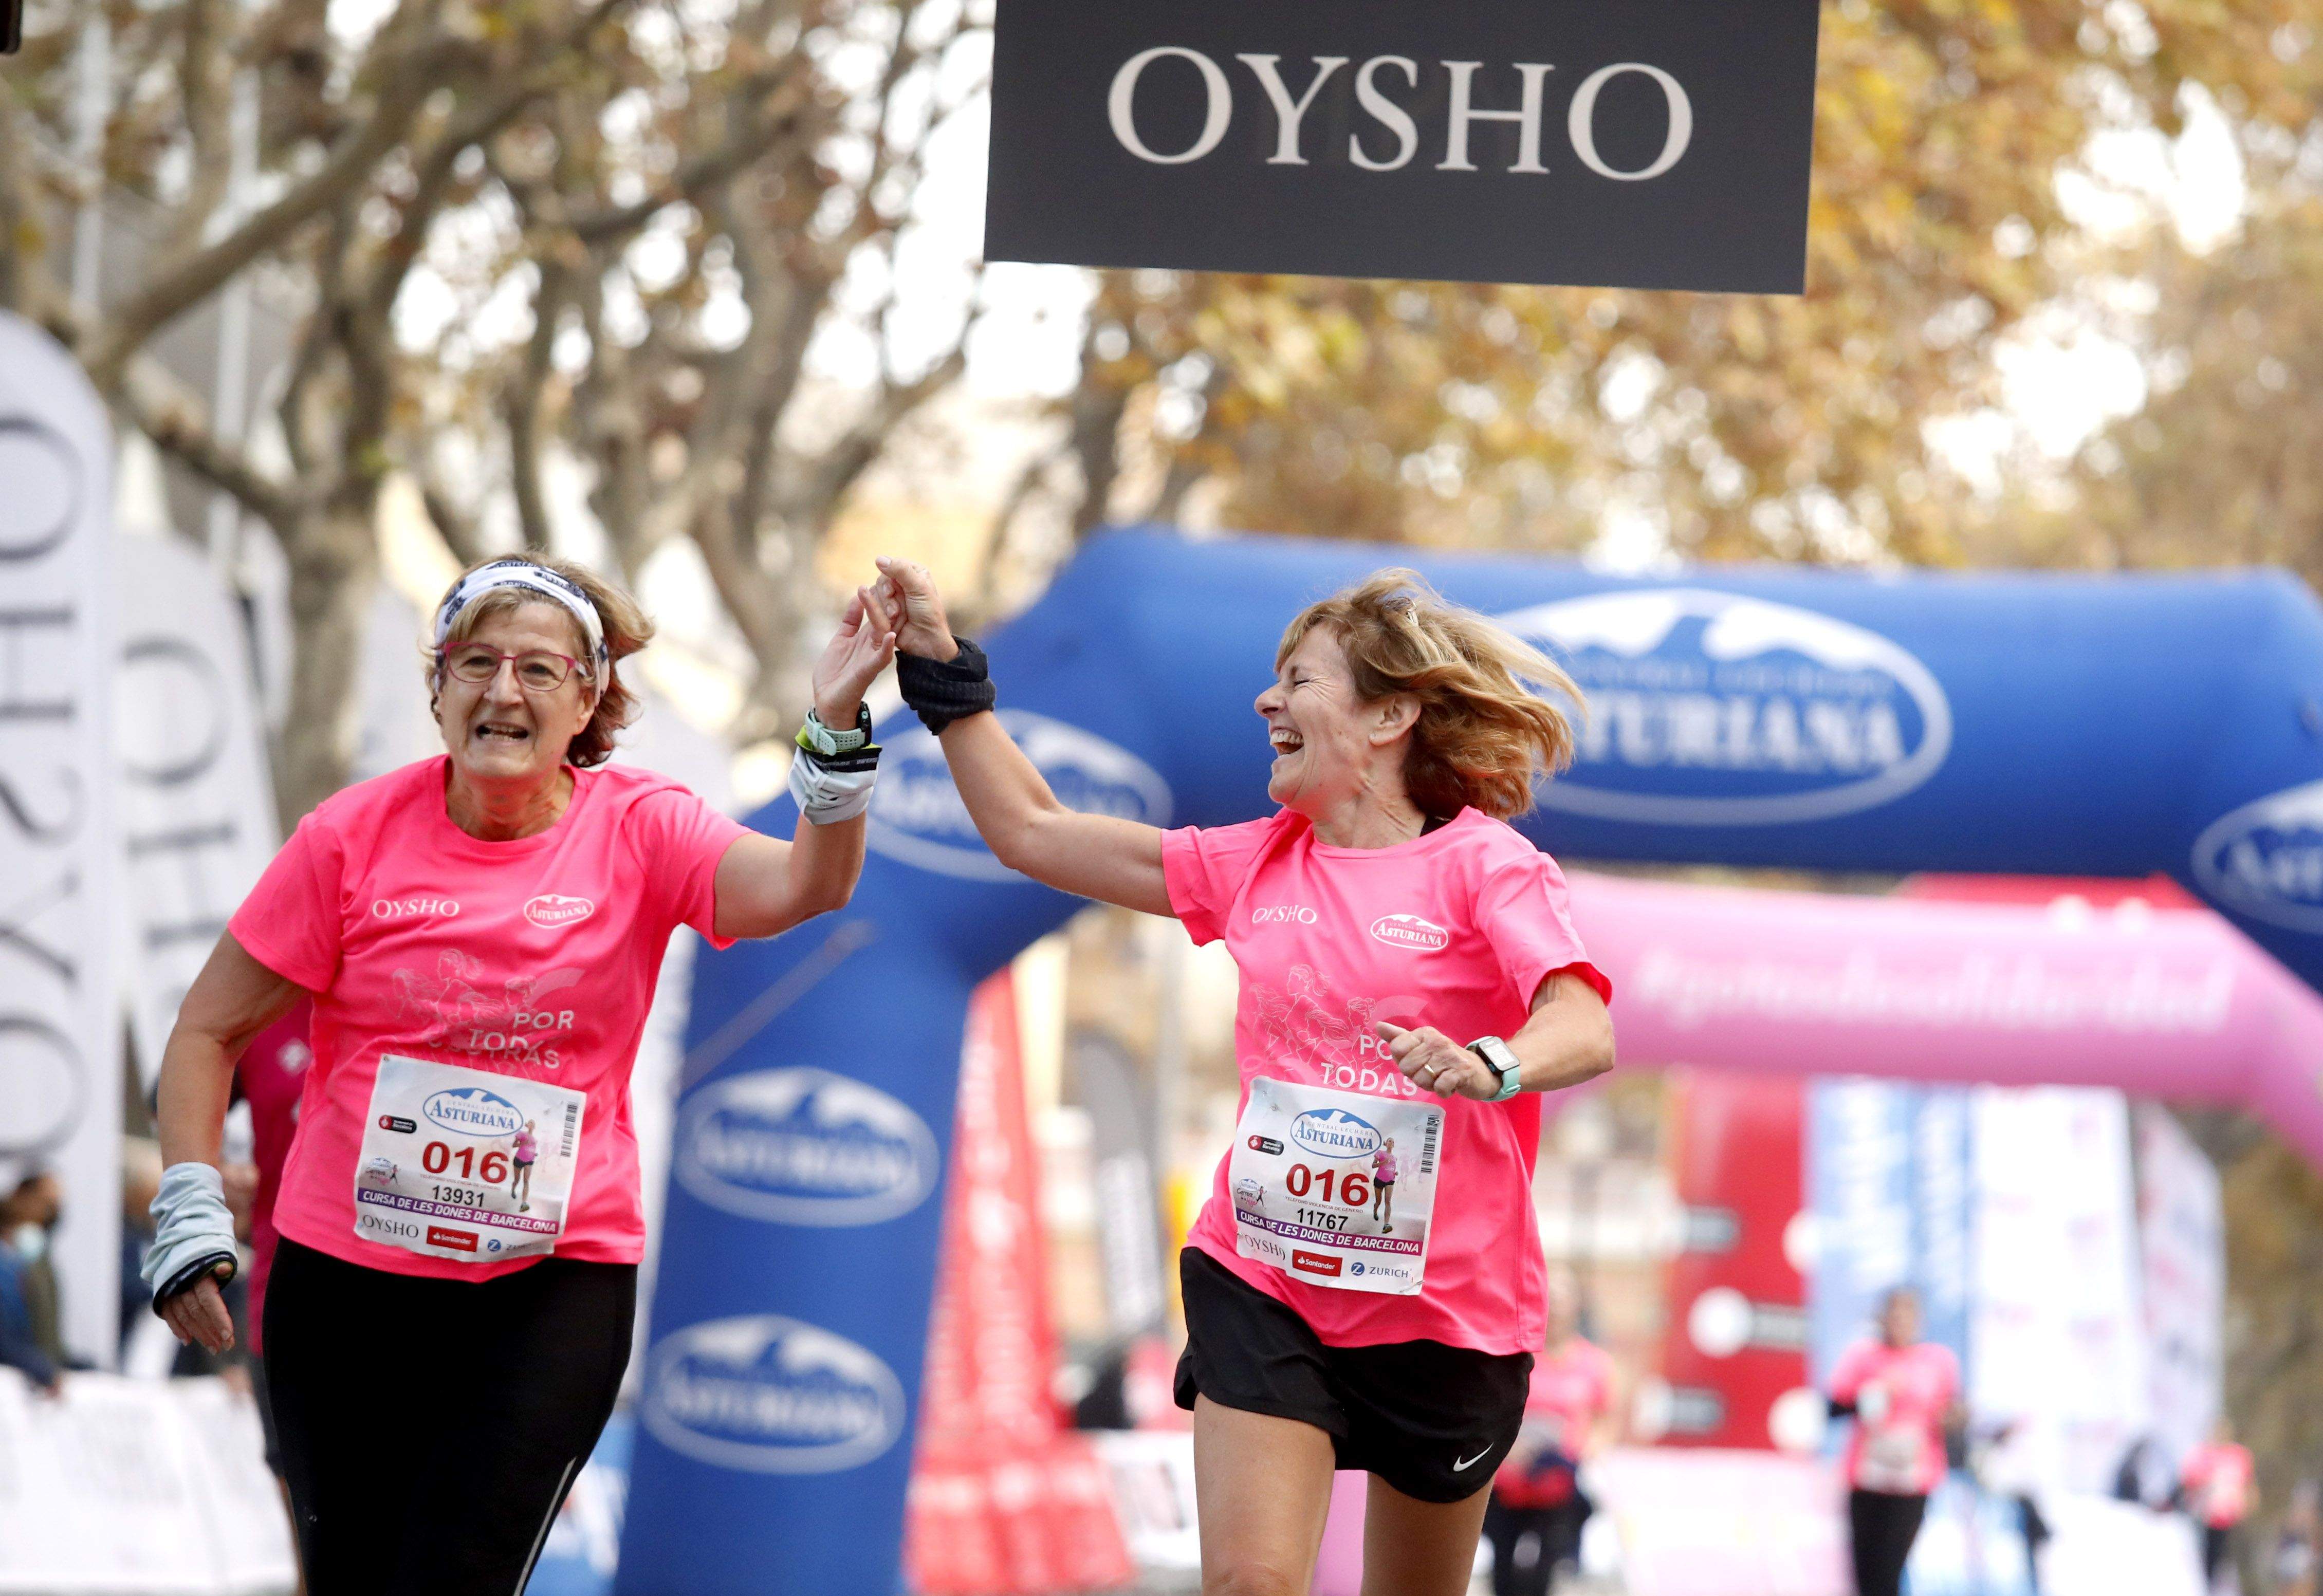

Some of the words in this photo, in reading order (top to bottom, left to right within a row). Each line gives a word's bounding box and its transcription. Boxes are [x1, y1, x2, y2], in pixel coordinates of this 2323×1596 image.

[1108, 45, 1694, 181] OYSHO
[372, 899, 459, 919] OYSHO
[528, 904, 588, 921] ASTURIANA
[1252, 904, 1318, 924] OYSHO
[1375, 922, 1442, 947] ASTURIANA
[513, 1010, 575, 1030] POR
[1359, 1034, 1394, 1061] PO
[1320, 1063, 1417, 1097] TODAS
[429, 1099, 514, 1130] ASTURIANA
[1294, 1120, 1374, 1150] ASTURIANA
[422, 1141, 509, 1183] 016
[433, 1184, 484, 1207] 13931
[1286, 1163, 1370, 1207] 016
[363, 1190, 395, 1206] CURSA
[397, 1197, 413, 1208] DE
[413, 1201, 434, 1213] LES
[435, 1204, 472, 1220] DONES
[473, 1212, 490, 1222] DE
[490, 1214, 556, 1232] BARCELONA
[1297, 1208, 1349, 1231] 11767
[363, 1214, 419, 1238] OYSHO
[1240, 1211, 1265, 1227] CURSA
[1266, 1220, 1278, 1232] DE
[1278, 1223, 1299, 1236] LES
[1300, 1228, 1335, 1244] DONES
[1336, 1235, 1352, 1246] DE
[1353, 1237, 1419, 1253] BARCELONA
[1304, 1258, 1335, 1270] Santander
[1370, 1267, 1409, 1278] ZURICH
